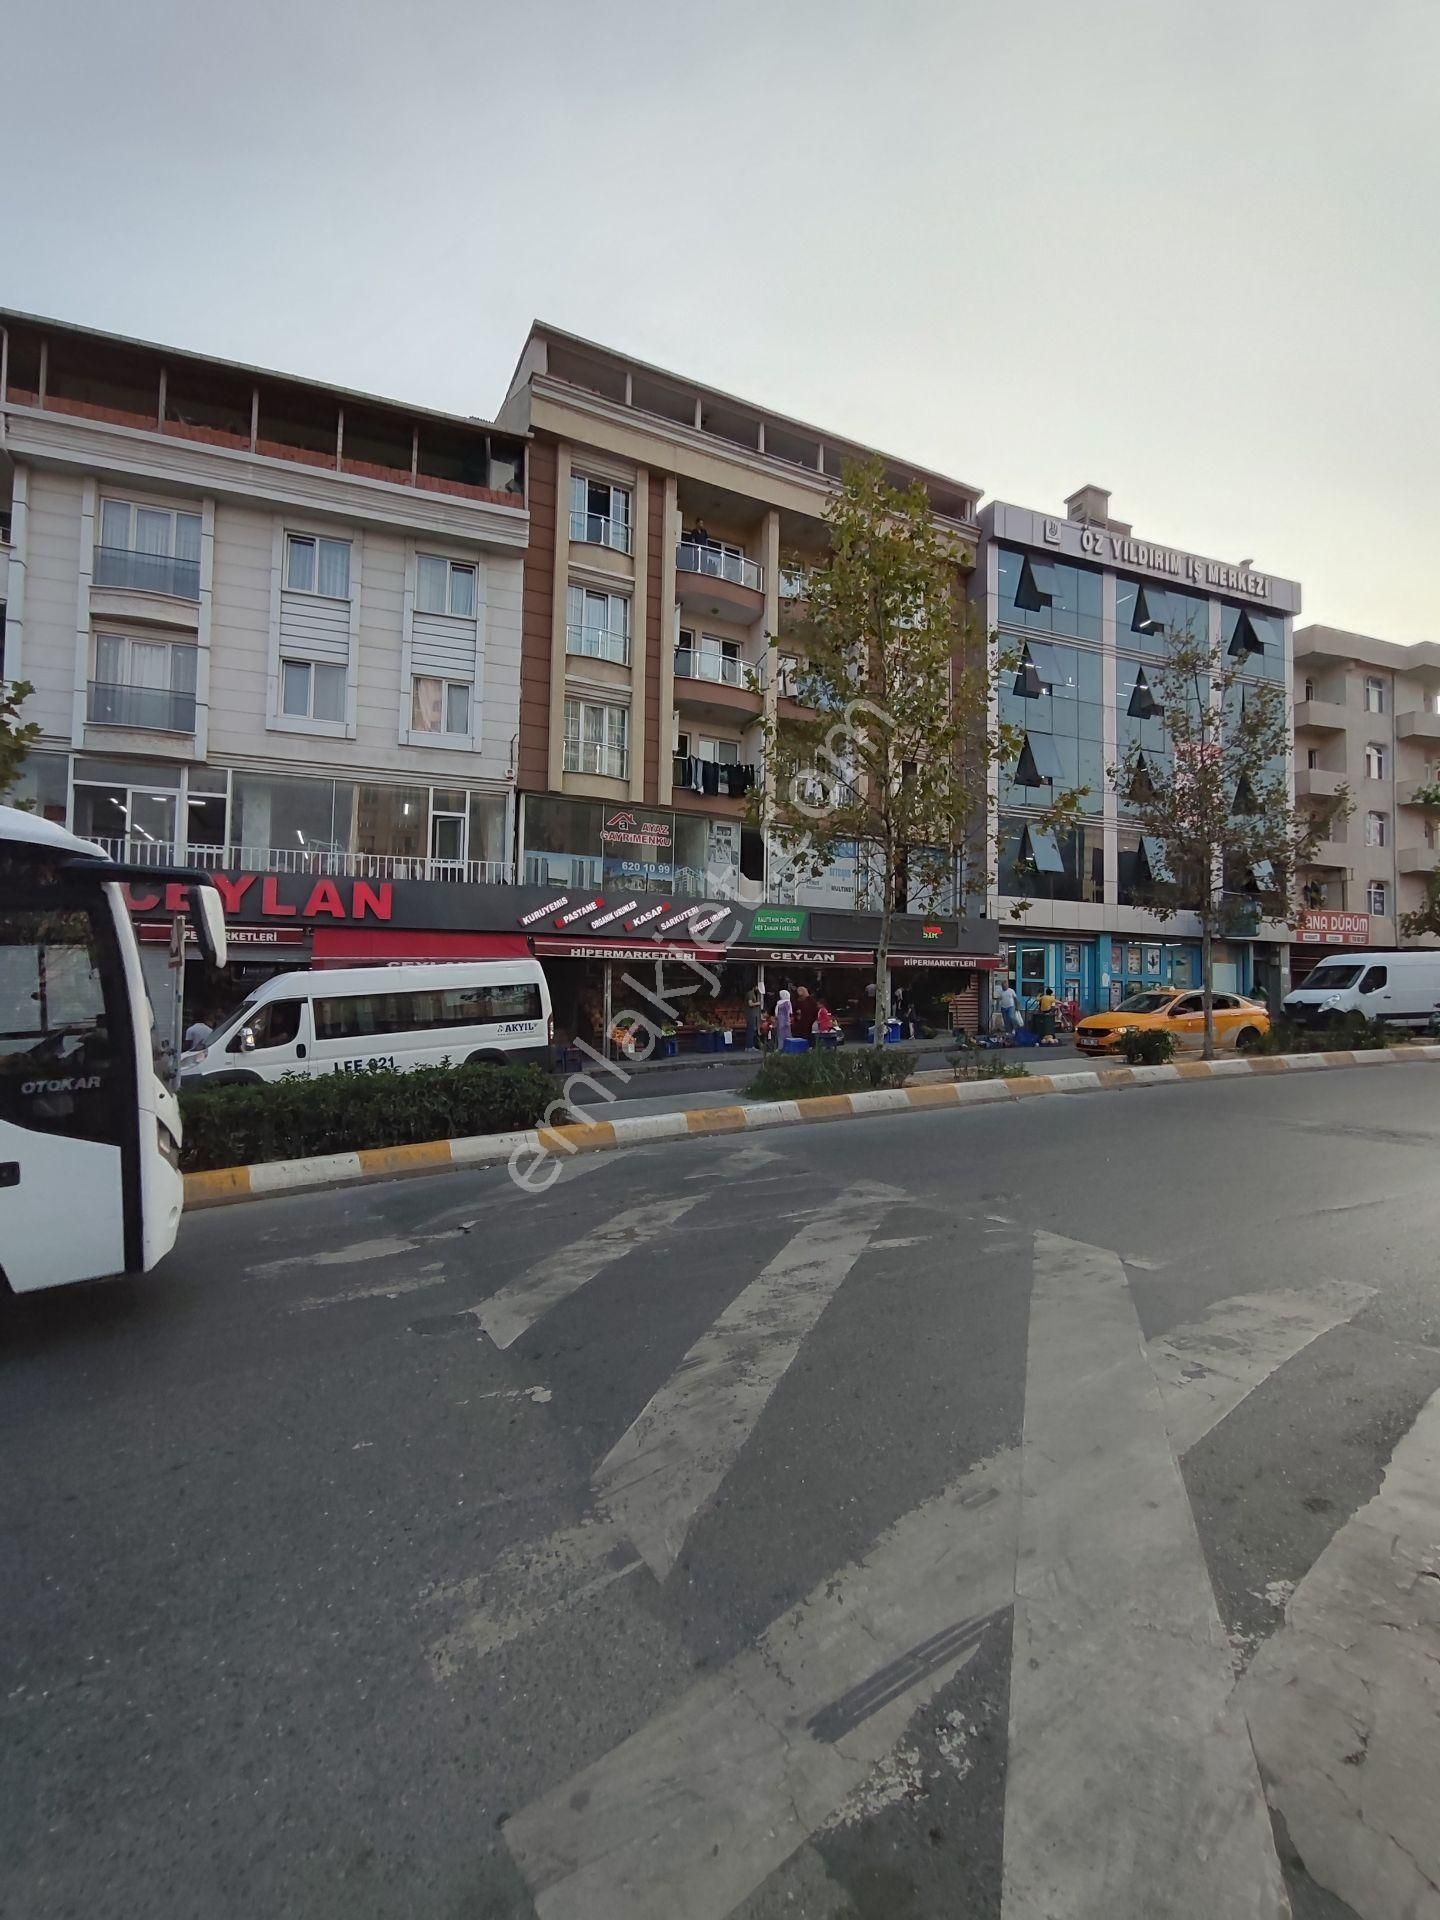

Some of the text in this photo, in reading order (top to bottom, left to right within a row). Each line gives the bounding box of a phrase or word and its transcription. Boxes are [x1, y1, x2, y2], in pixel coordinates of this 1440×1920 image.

[1081, 525, 1103, 555] ÖZ
[1112, 538, 1182, 576] YILDIRIM
[1207, 564, 1270, 598] MERKEZİ
[641, 822, 669, 835] AYAZ
[621, 861, 670, 874] 620 10 99
[563, 901, 598, 924] PASTANE
[633, 905, 663, 927] KASAP
[570, 947, 696, 961] HİPERMARKETLERİ
[770, 952, 835, 962] CEYLAN
[21, 1076, 101, 1094] OTOKAR
